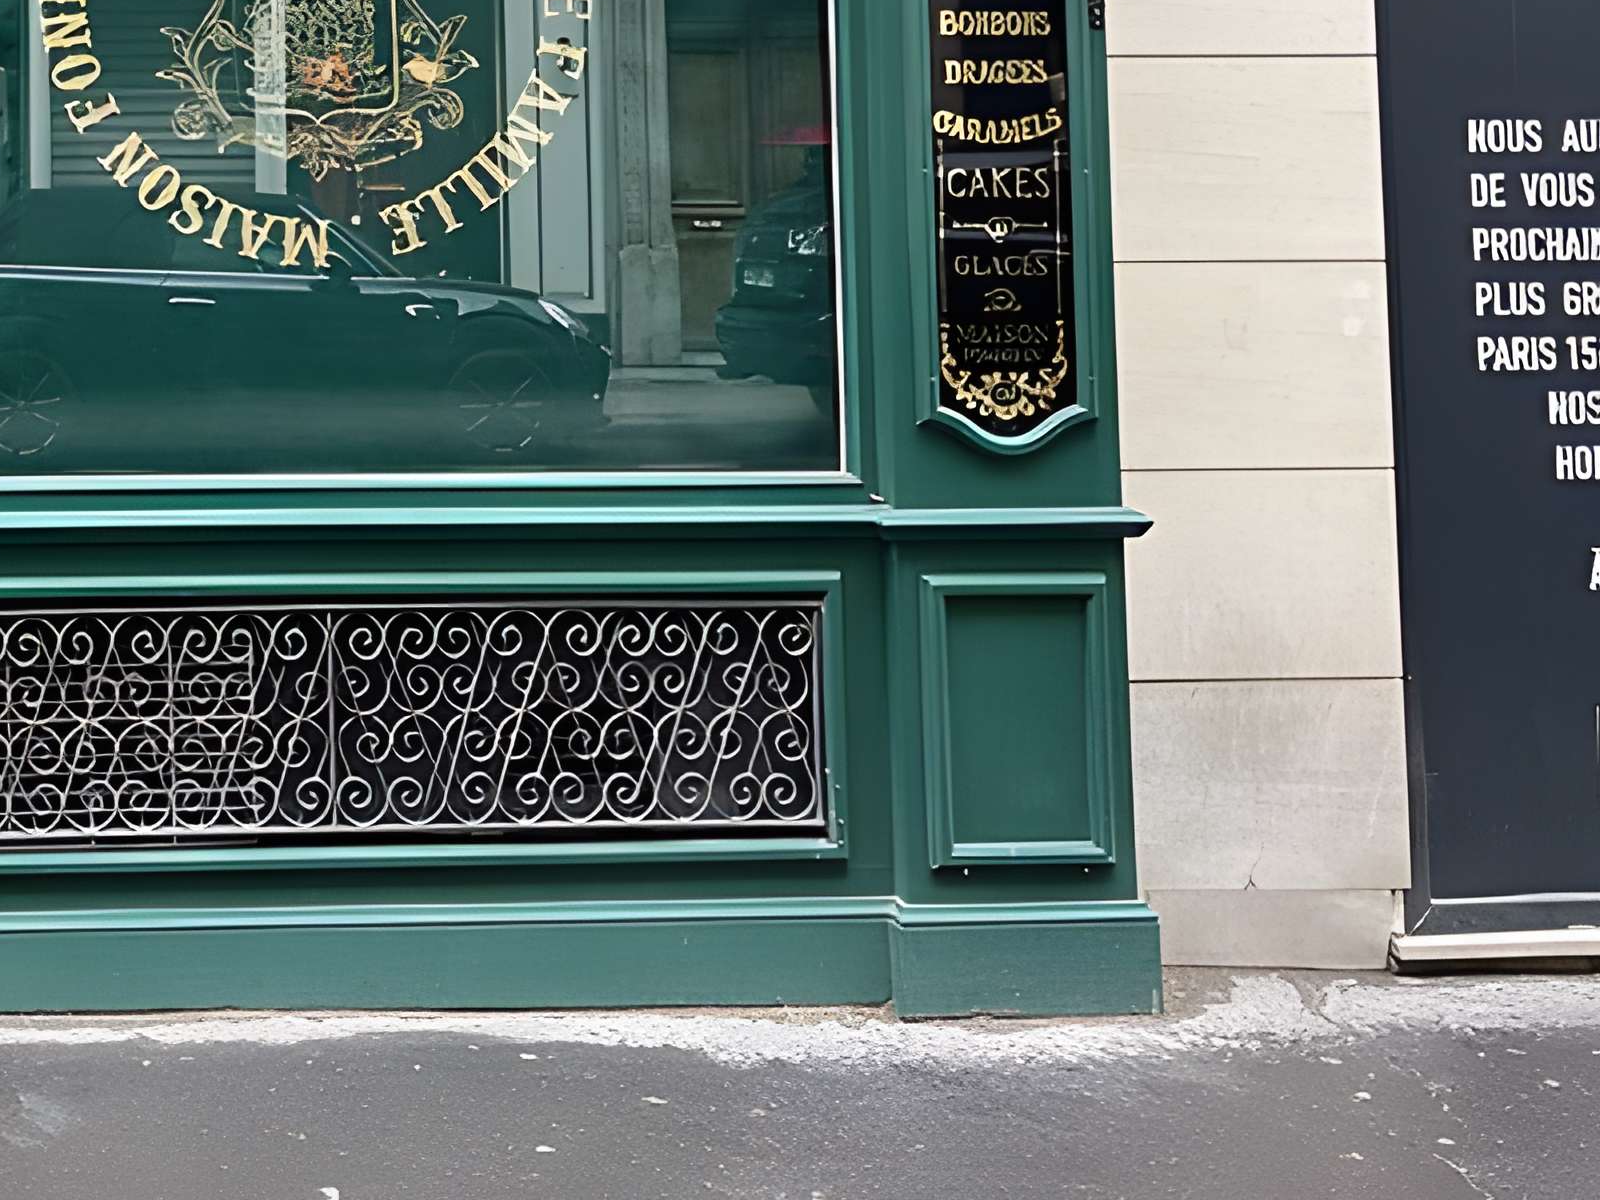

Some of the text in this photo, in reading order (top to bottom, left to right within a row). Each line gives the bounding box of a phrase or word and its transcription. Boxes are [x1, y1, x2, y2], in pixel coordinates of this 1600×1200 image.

[939, 9, 1051, 36] BONBONS
[377, 36, 590, 257] FAMILLE
[96, 131, 335, 269] MAISON
[947, 167, 1050, 199] CAKES
[1470, 172, 1596, 208] DE VOUS
[954, 255, 1049, 276] GLACES
[1475, 281, 1546, 316] PLUS
[1477, 336, 1558, 371] PARIS
